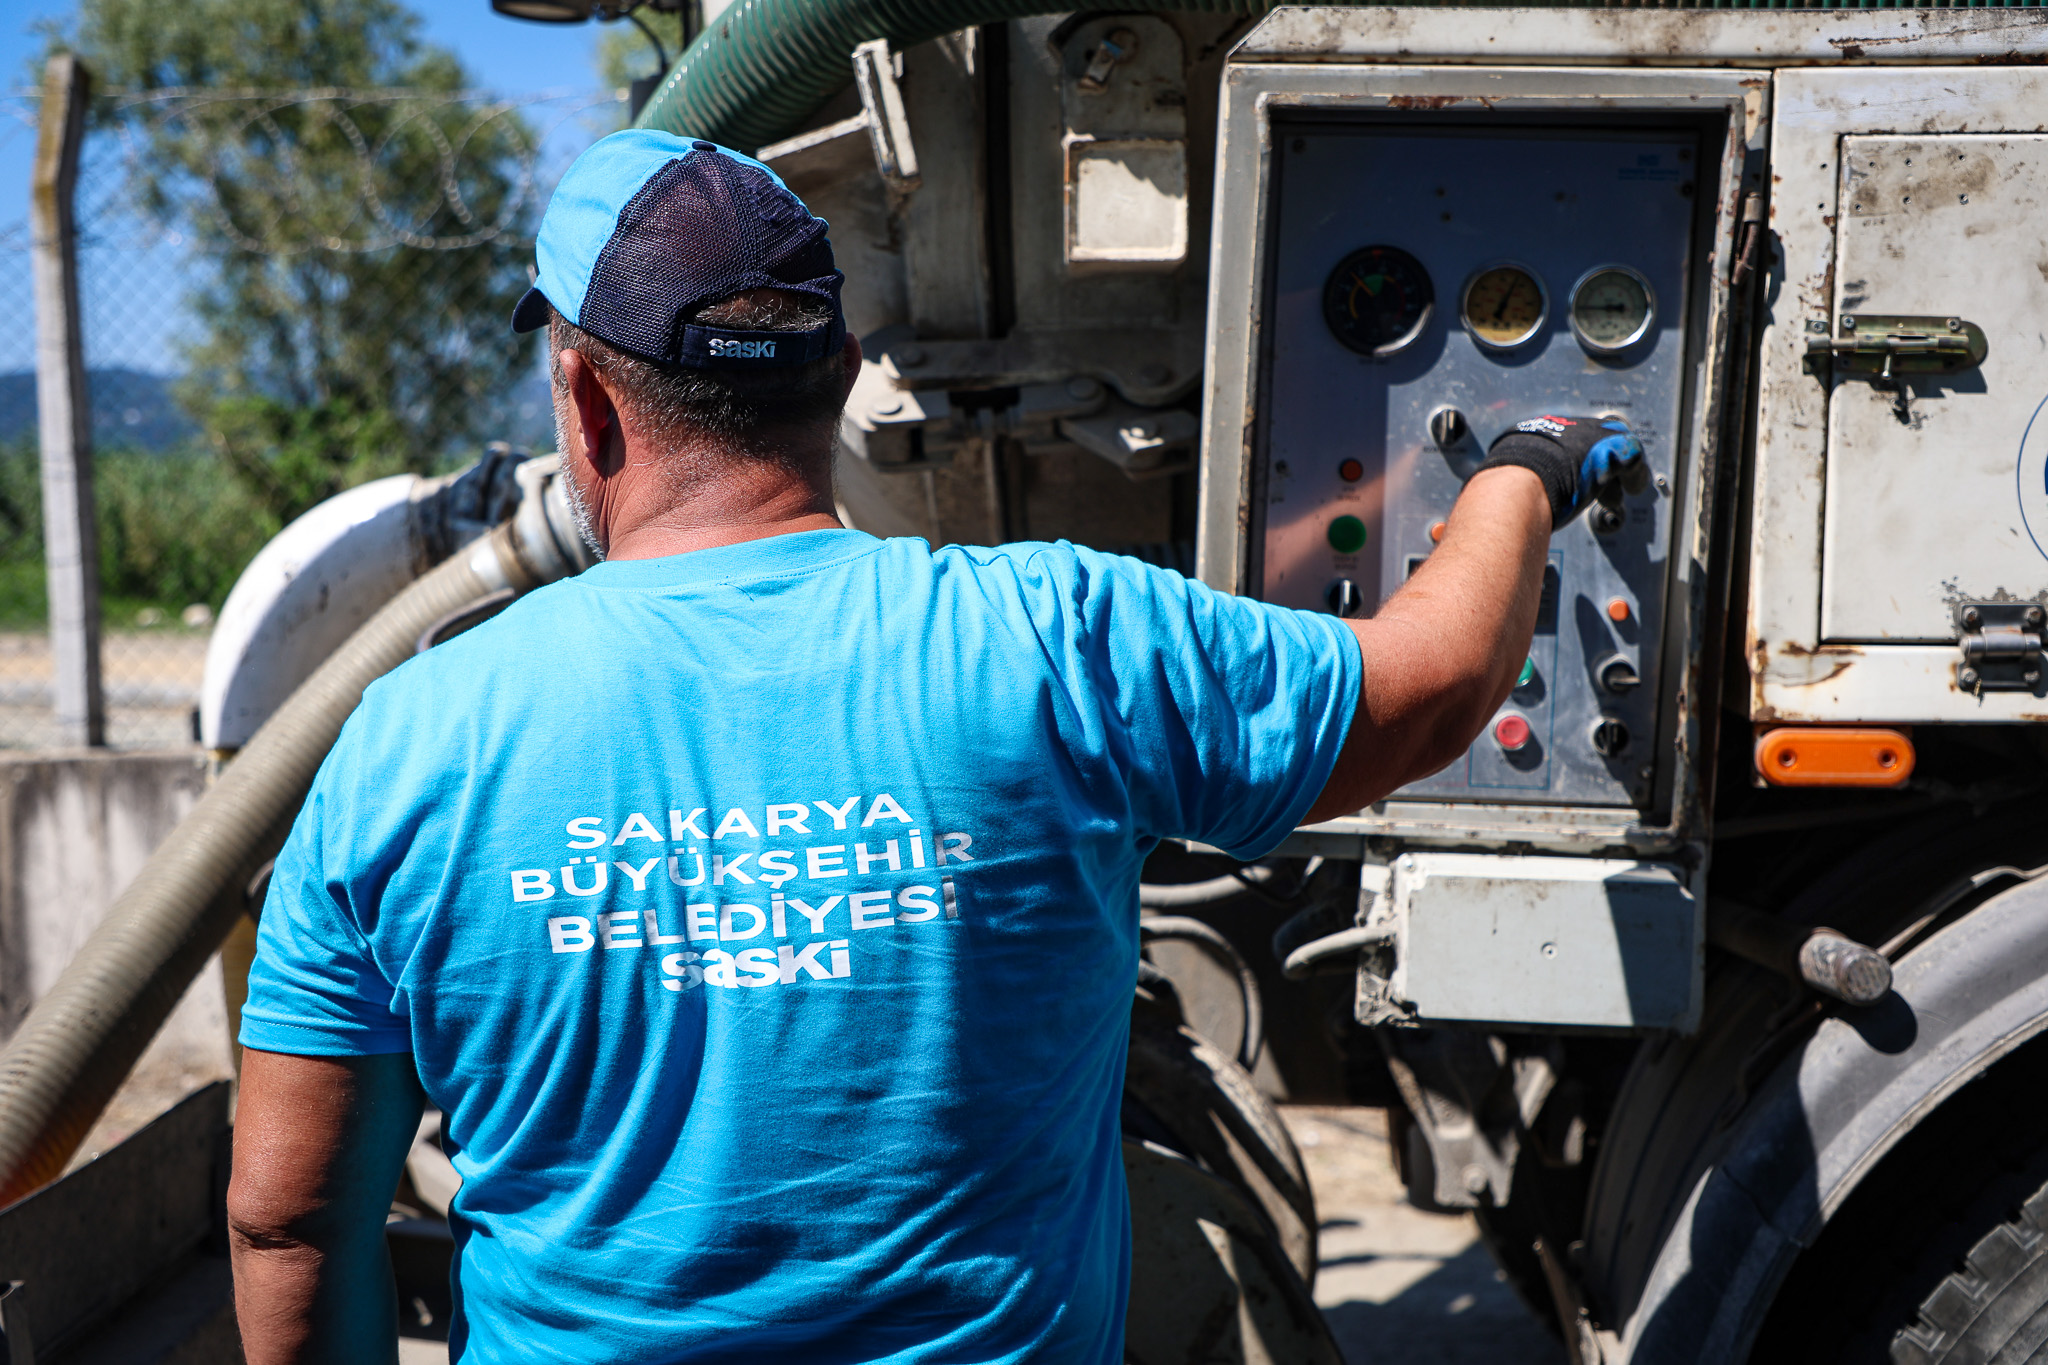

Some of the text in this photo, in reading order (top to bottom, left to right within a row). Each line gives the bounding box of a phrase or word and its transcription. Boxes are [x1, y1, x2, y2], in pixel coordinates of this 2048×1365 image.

[565, 793, 914, 850] SAKARYA
[511, 828, 975, 902] BÜYÜKŞEHİR
[547, 875, 959, 954] BELEDİYESİ
